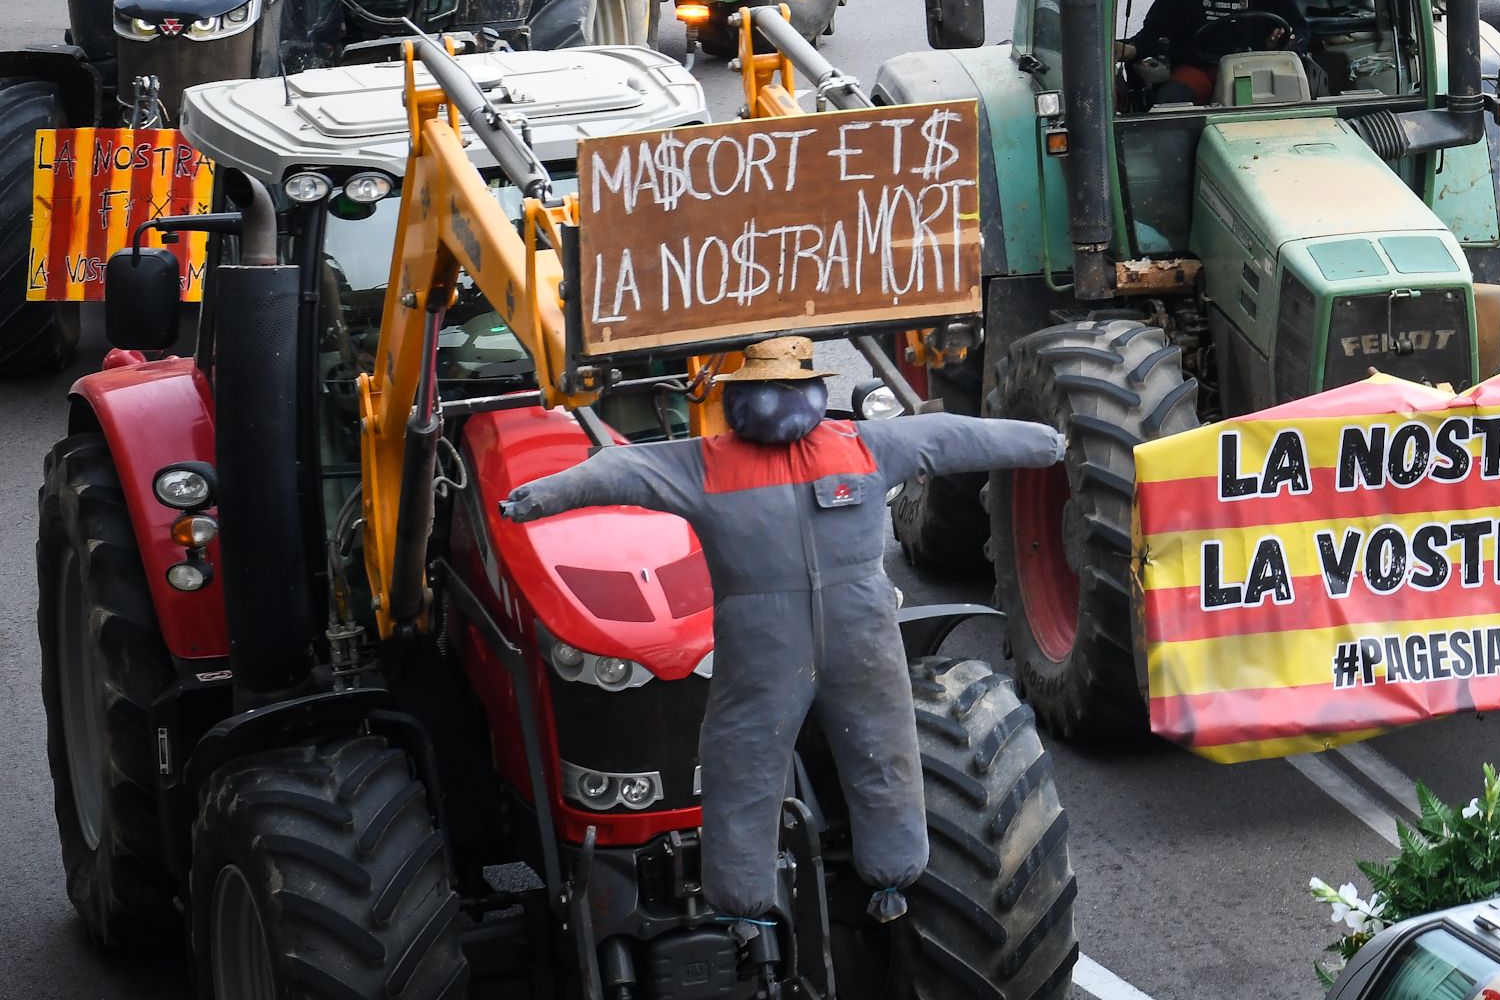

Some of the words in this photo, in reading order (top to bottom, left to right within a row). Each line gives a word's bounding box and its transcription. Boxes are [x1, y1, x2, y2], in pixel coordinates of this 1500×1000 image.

[38, 137, 77, 179] LA
[93, 137, 216, 180] NOSTRA
[29, 247, 50, 291] LA
[65, 250, 108, 285] VOST
[592, 247, 642, 324] LA
[1219, 430, 1310, 501] LA
[1201, 537, 1293, 610] LA
